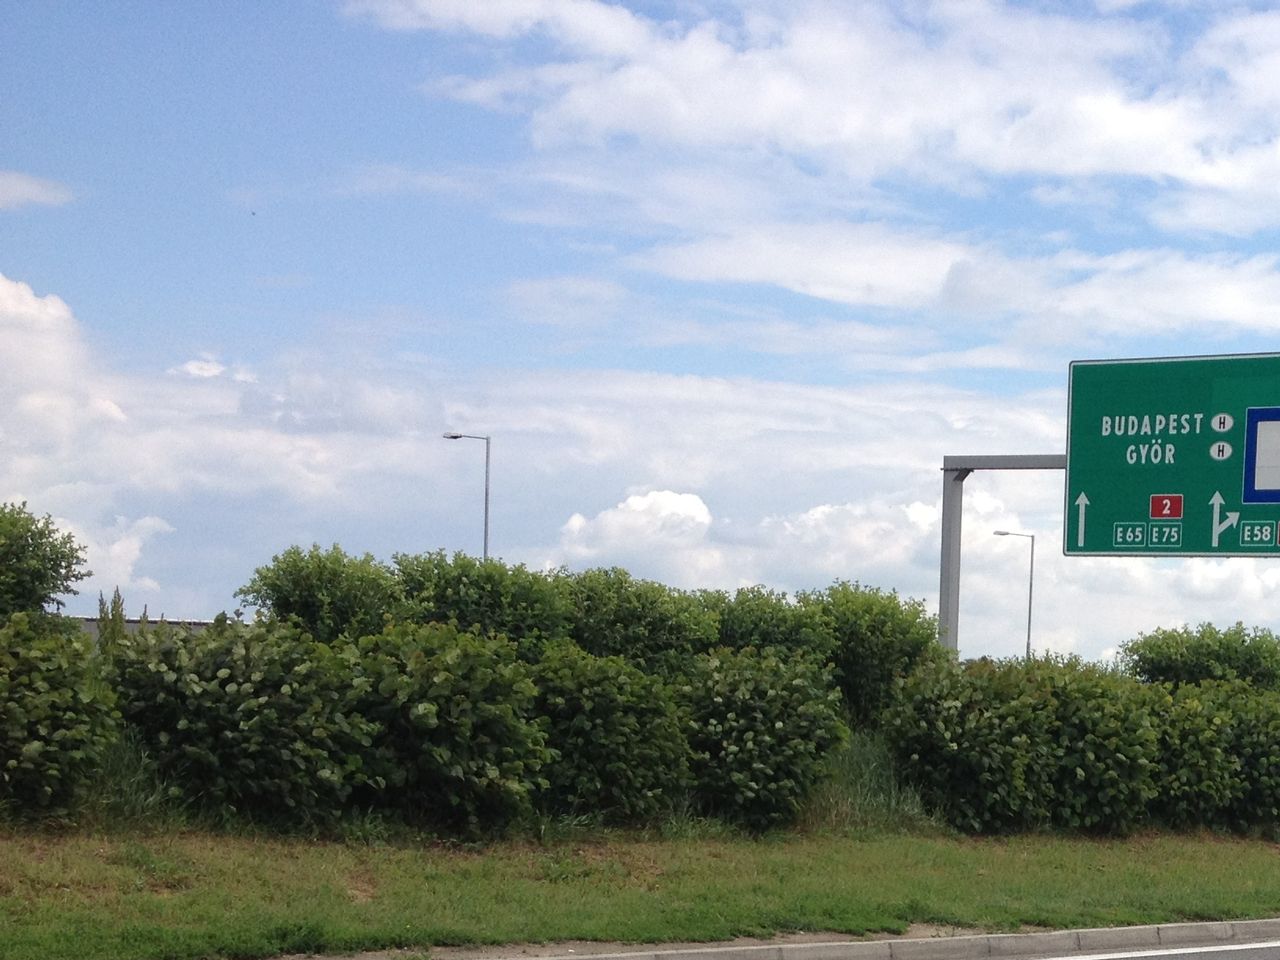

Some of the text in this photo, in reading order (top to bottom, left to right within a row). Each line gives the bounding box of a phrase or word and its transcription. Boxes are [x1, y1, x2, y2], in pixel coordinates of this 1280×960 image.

[1102, 413, 1226, 436] BUDAPEST H
[1126, 439, 1225, 464] GYÖR H
[1161, 499, 1171, 514] 2
